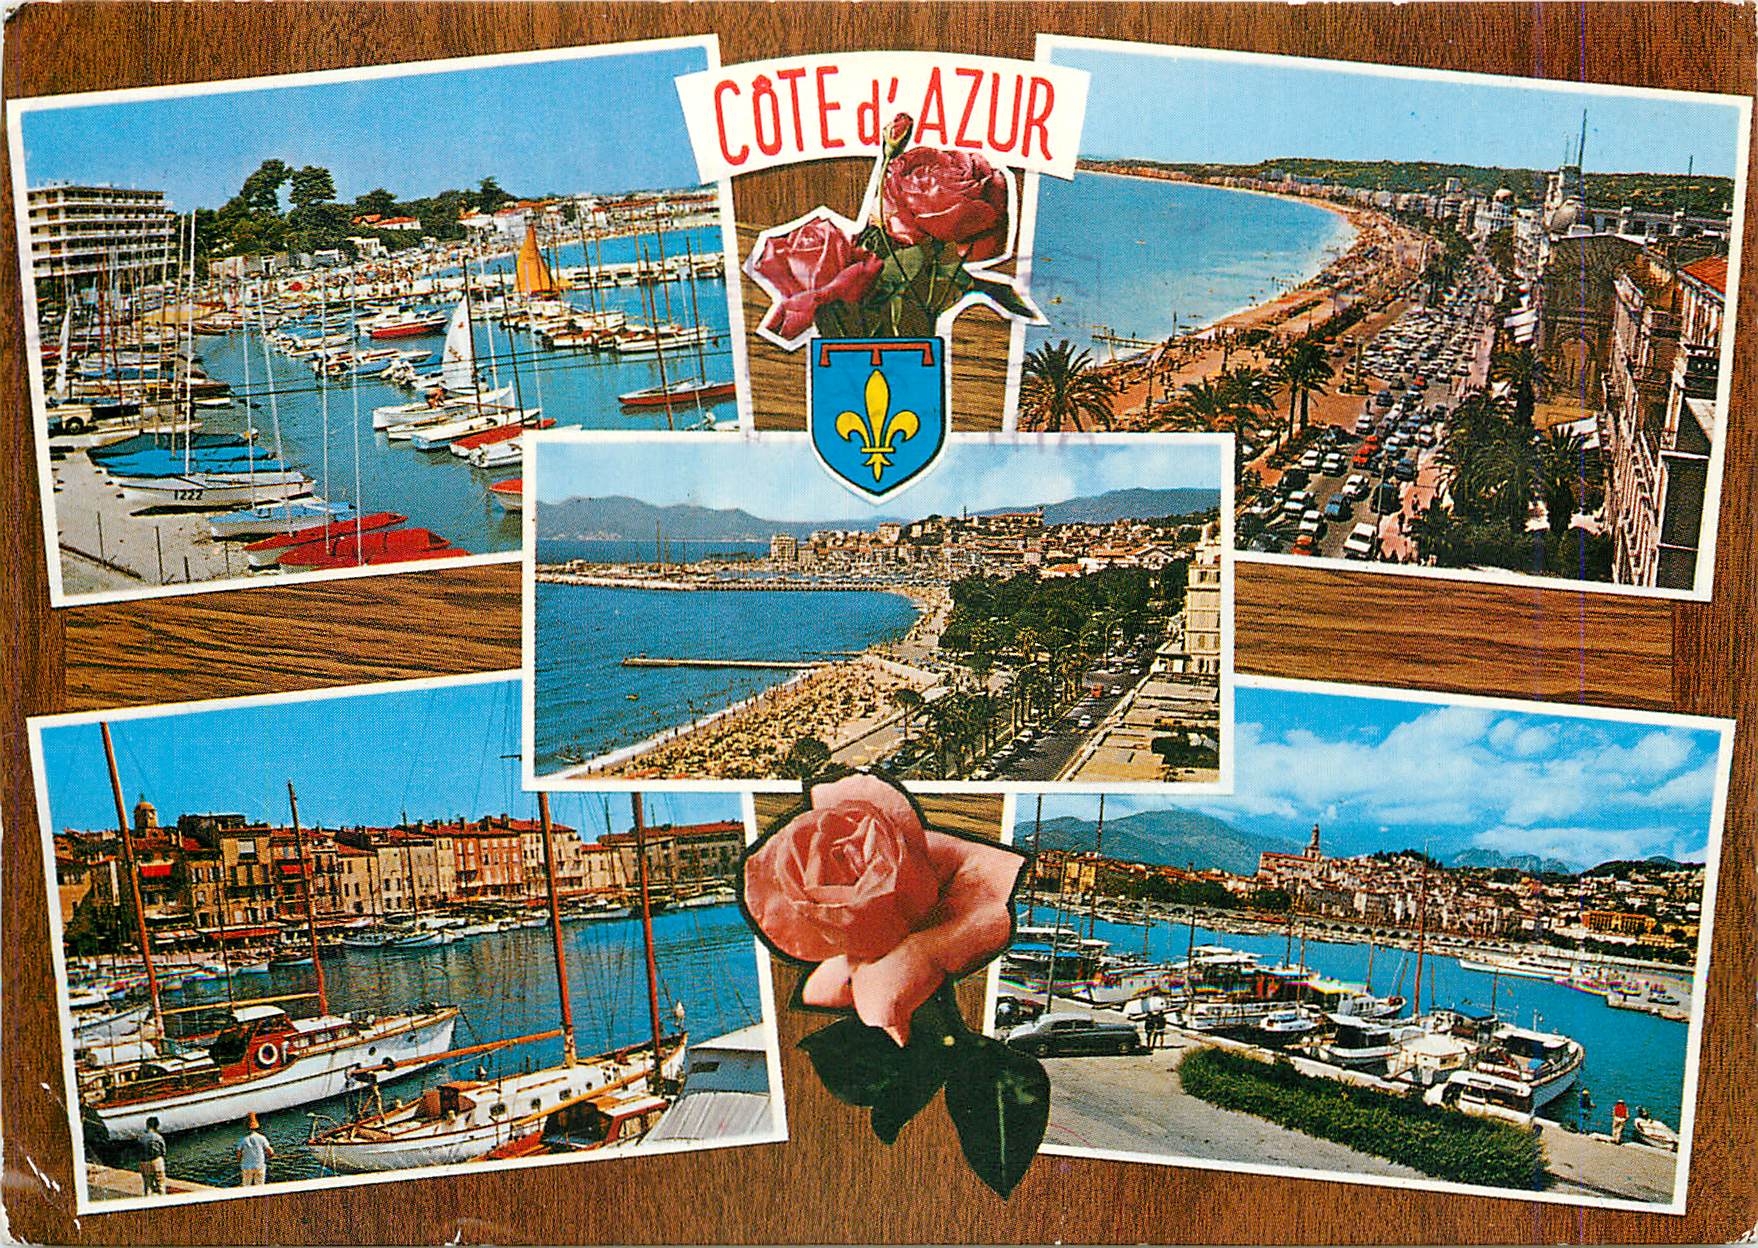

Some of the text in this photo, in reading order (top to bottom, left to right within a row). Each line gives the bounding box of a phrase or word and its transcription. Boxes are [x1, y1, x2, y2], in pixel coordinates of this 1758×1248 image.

[714, 65, 844, 167] CÔTE
[914, 66, 1054, 161] AZUR
[174, 489, 204, 501] 1222
